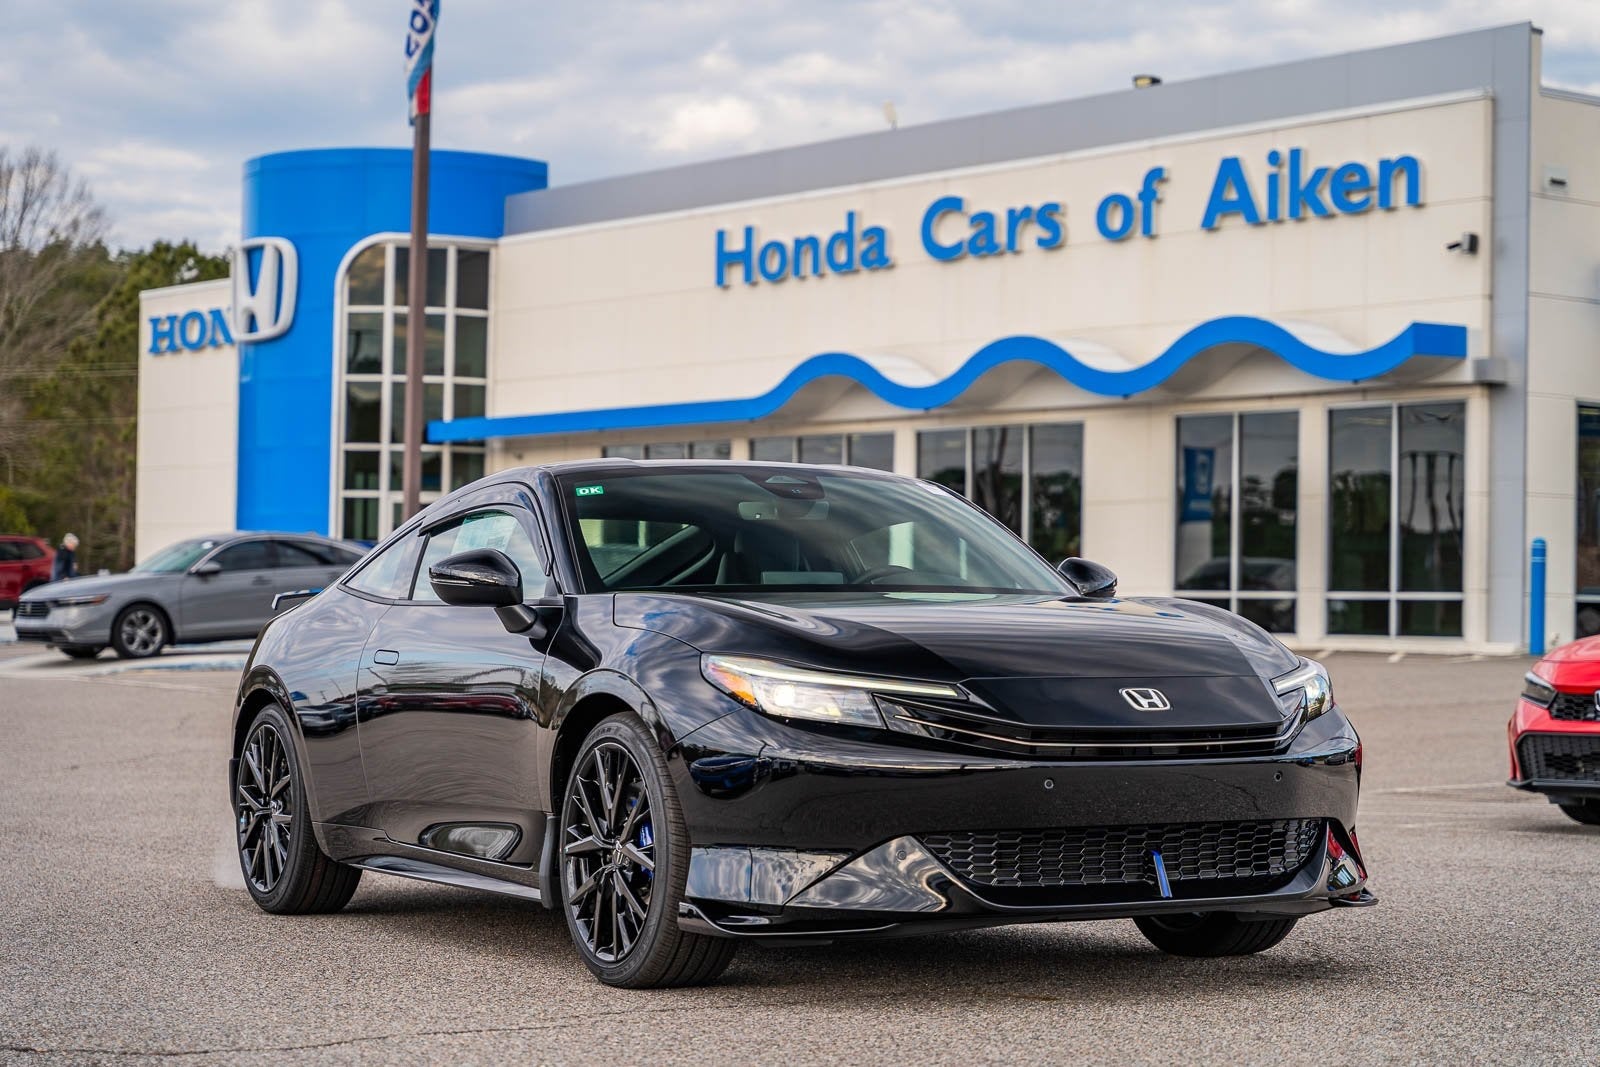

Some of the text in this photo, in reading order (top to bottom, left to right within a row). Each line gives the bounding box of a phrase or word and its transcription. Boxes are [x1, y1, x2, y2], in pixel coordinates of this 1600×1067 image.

[715, 147, 1422, 288] Honda Cars of Aiken
[579, 486, 601, 495] OK
